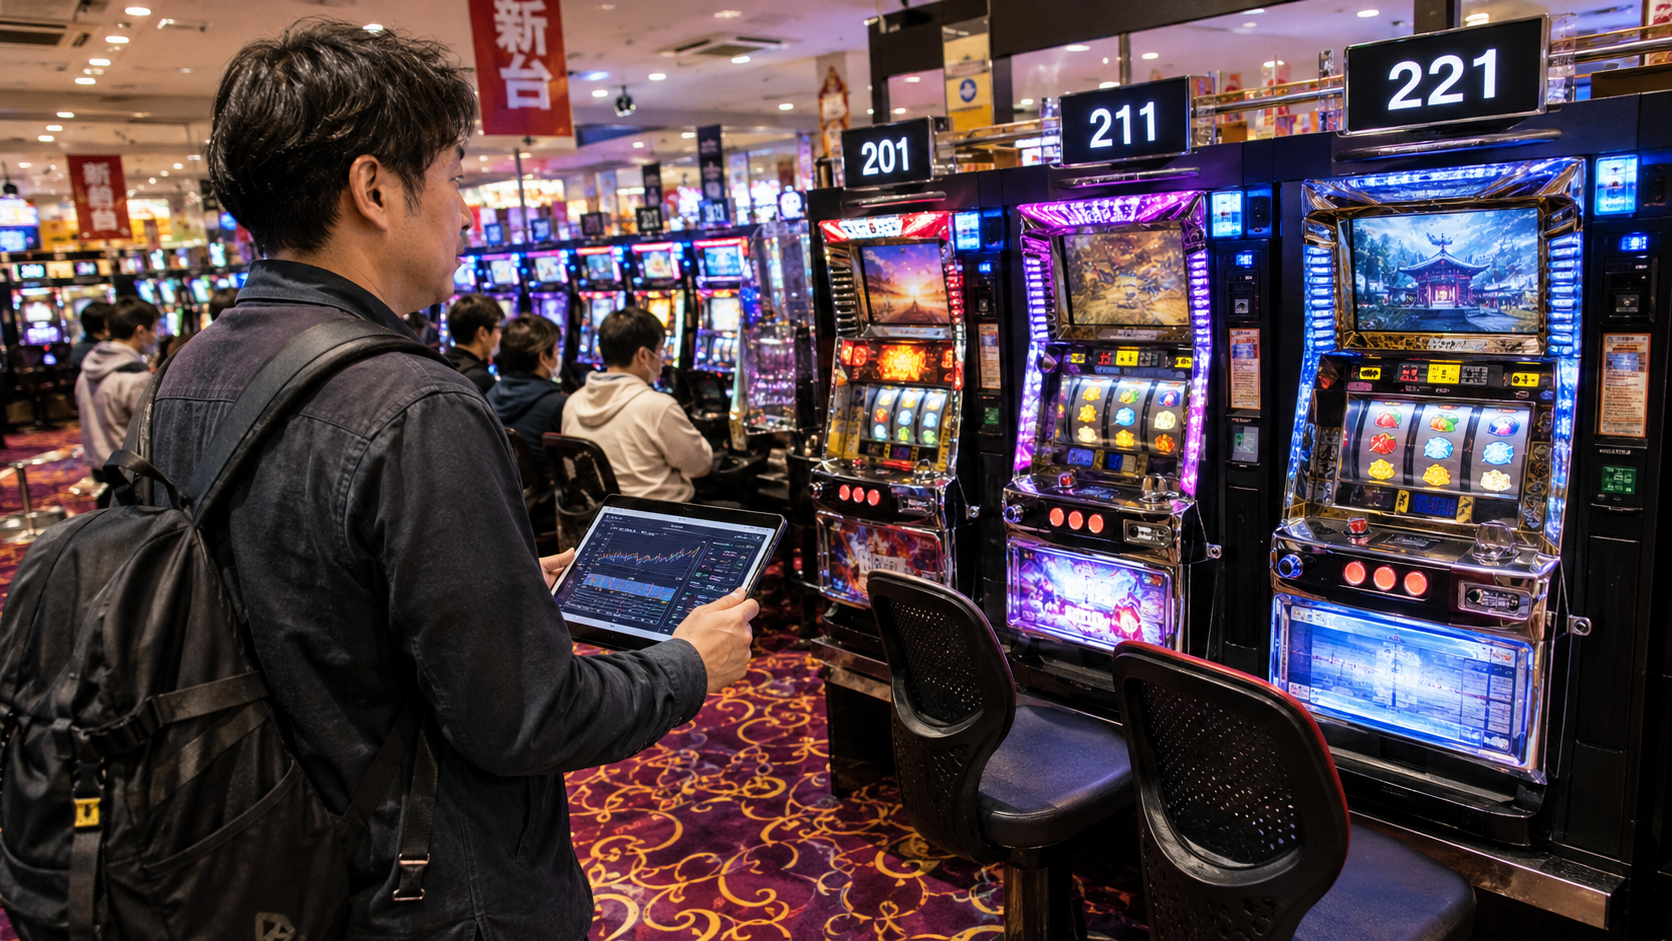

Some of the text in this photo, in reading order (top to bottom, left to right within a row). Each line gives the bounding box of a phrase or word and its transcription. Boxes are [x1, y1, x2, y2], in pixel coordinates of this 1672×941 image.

[493, 0, 554, 110] 新台
[1387, 48, 1497, 111] 221
[1089, 101, 1156, 149] 211
[861, 136, 909, 176] 201
